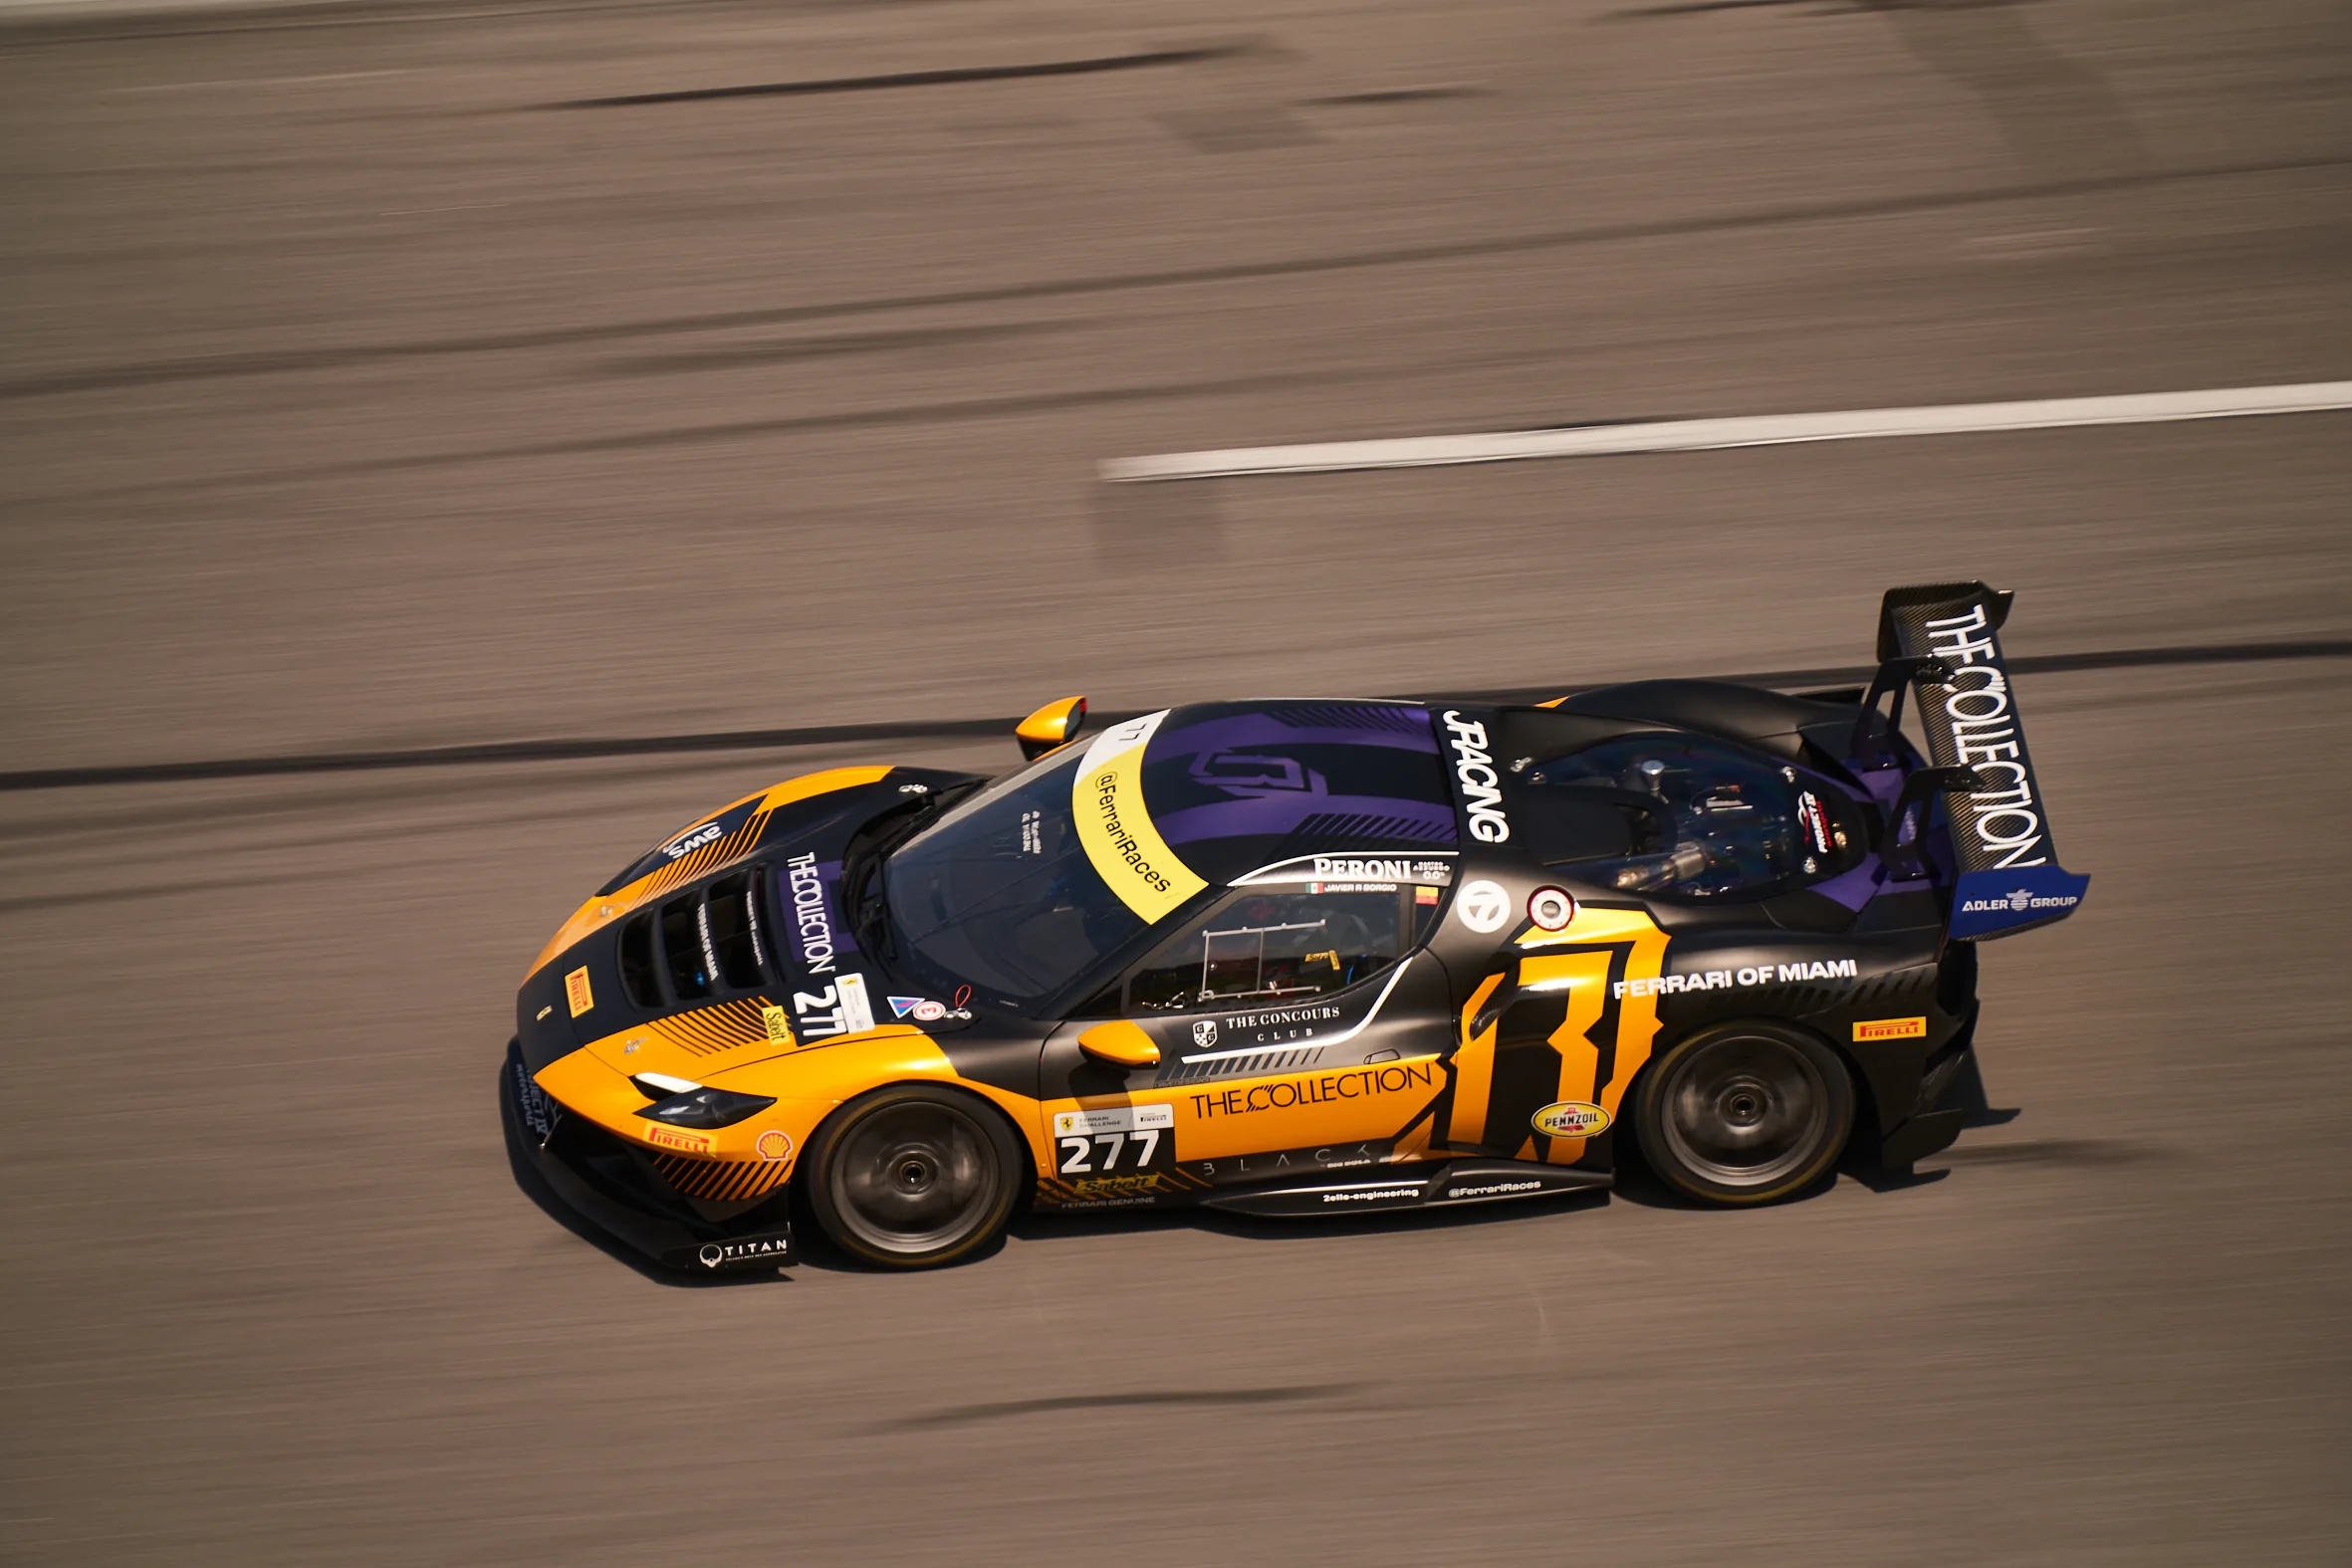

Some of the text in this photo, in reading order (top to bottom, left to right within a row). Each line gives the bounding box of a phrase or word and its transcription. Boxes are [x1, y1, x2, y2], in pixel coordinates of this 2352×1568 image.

[1926, 604, 1995, 664] THE
[1442, 709, 1510, 843] JRACING
[668, 823, 722, 859] aws
[1095, 772, 1171, 892] @FerrariRaces
[1313, 857, 1411, 880] PERONI
[1324, 883, 1354, 892] JAVIER
[788, 852, 834, 975] THE COLLECTION
[1963, 896, 2077, 912] ADLER GROUP
[570, 972, 589, 1010] PIRELLI
[1613, 959, 1858, 1000] FERRARI OF MIAMI
[794, 986, 846, 1036] 277
[1226, 1007, 1340, 1029] THE CONCOURS
[766, 1011, 787, 1041] Sabelt
[1859, 1021, 1919, 1037] PIRELLI
[1190, 1065, 1432, 1119] THE COLLECTION
[1545, 1113, 1598, 1127] PENNZOIL
[649, 1127, 710, 1154] PIRELLI
[1060, 1129, 1160, 1174] 277
[1083, 1176, 1150, 1193] Sabelt
[1449, 1181, 1541, 1198] @FerrariRaces
[1061, 1197, 1156, 1209] FERRARI GENUINE
[725, 1239, 787, 1256] TITAN
